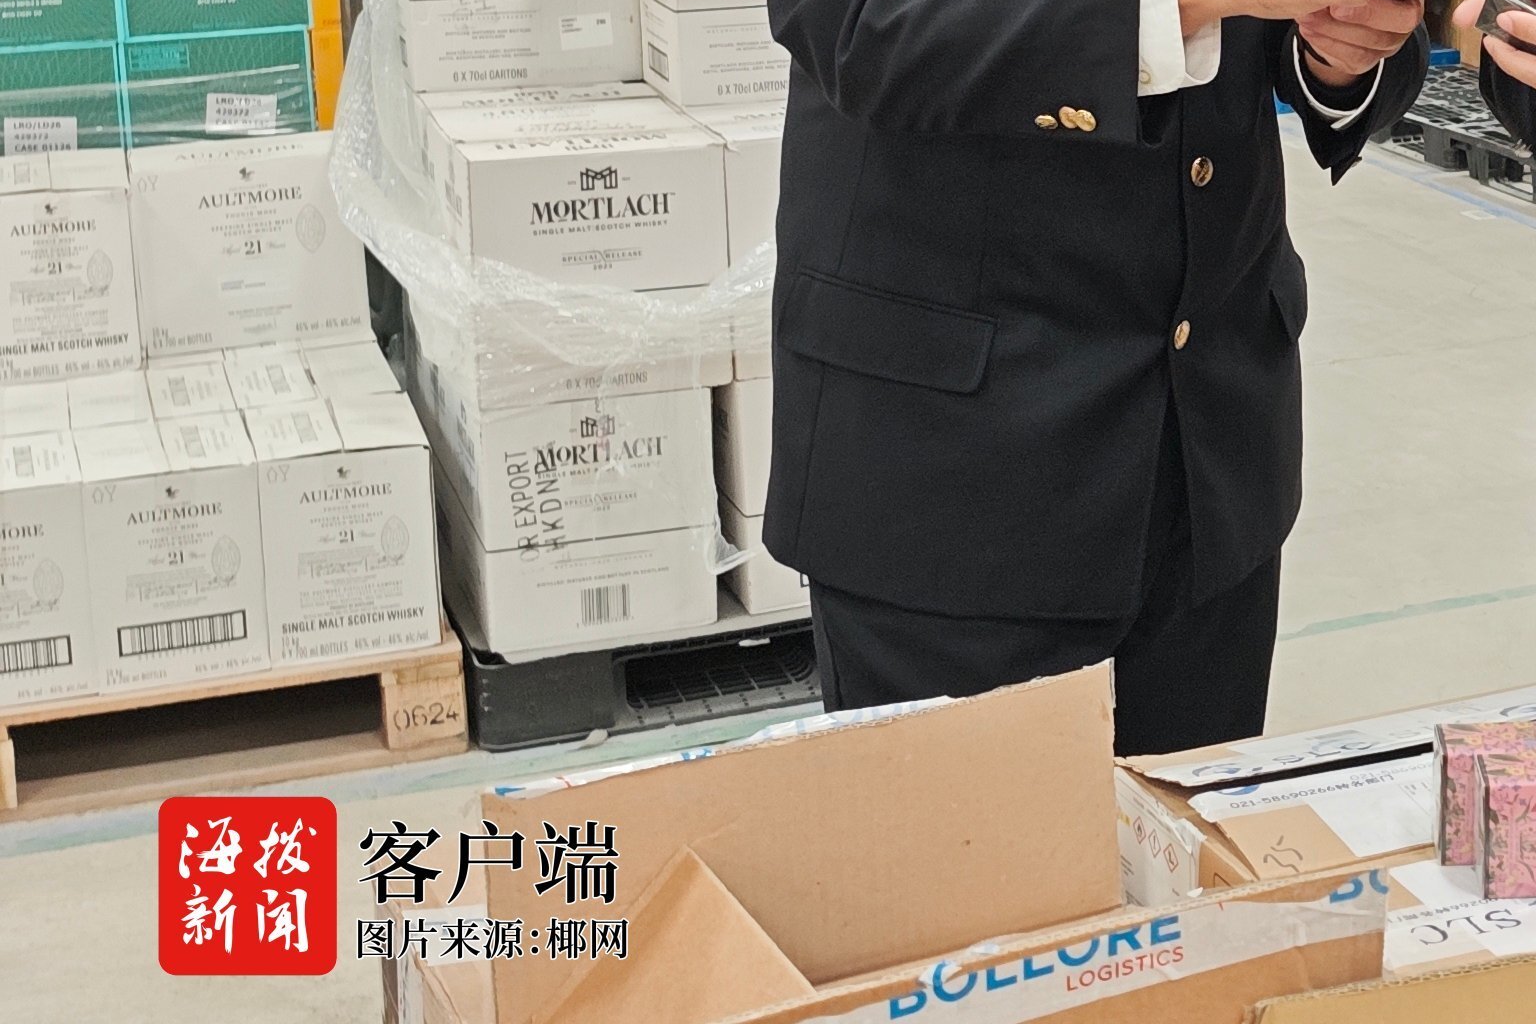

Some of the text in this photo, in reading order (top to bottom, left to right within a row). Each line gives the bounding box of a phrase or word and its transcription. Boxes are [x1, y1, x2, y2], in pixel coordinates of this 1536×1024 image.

[461, 70, 467, 82] X
[489, 68, 528, 81] CARTONS
[725, 85, 731, 95] X
[198, 186, 302, 210] AULTMORE
[530, 192, 671, 226] MORTLACH
[10, 219, 97, 237] AULTMORE
[533, 219, 668, 236] SINGLE MALT SCOTCH WHISKY
[244, 239, 262, 256] 21
[47, 262, 63, 276] 21
[31, 332, 129, 353] MALT SCOTCH WHISKY
[300, 483, 392, 505] AULTMORE
[504, 451, 538, 529] EXPORT
[126, 502, 223, 527] AULTMORE
[338, 529, 354, 544] 21
[168, 551, 185, 566] 21
[282, 606, 425, 634] SINGLE MALT SCOTCH WHISKY
[320, 641, 349, 657] BOTTLES
[393, 702, 460, 733] 0624
[1410, 908, 1522, 945] SLC
[1065, 944, 1185, 992] LOGISTICS
